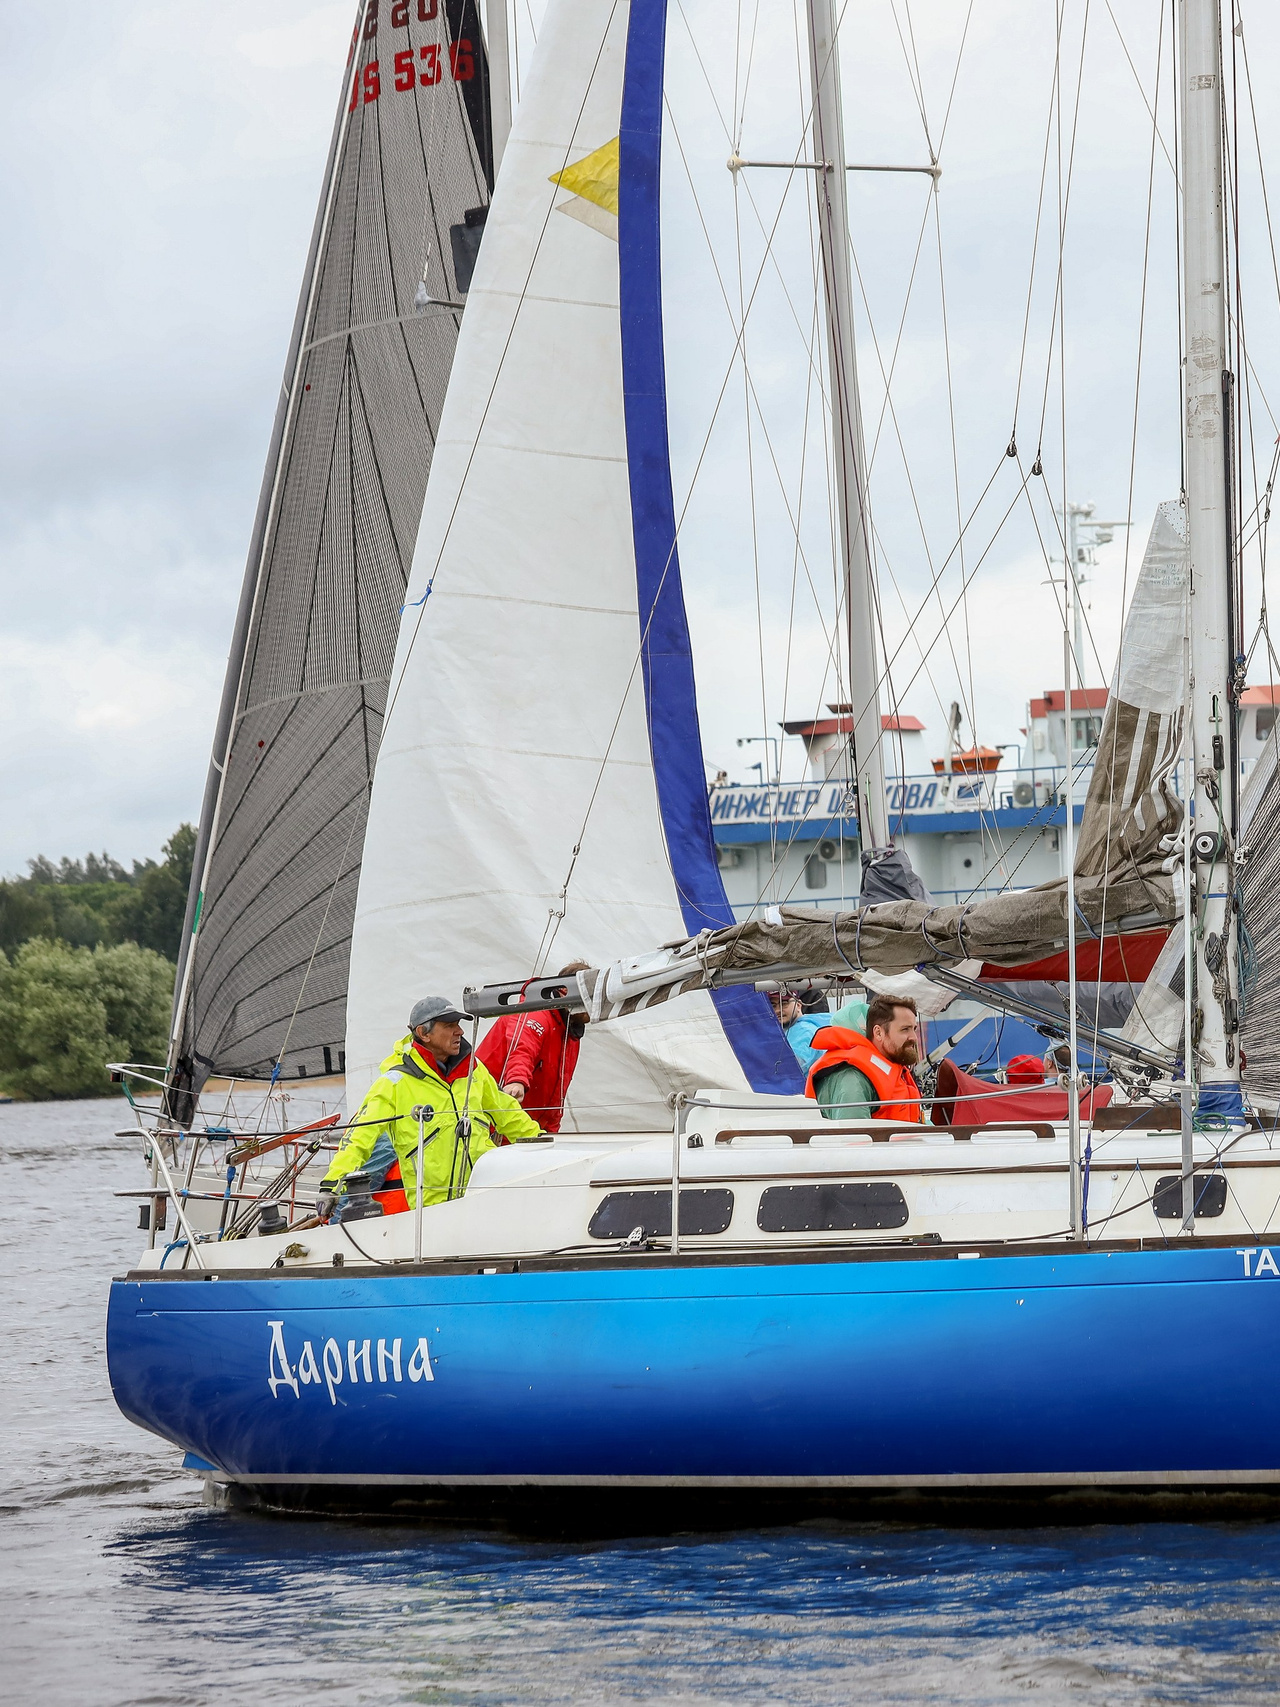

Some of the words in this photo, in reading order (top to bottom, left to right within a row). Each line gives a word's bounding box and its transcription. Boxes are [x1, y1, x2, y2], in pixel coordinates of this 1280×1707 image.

[394, 38, 475, 93] 536
[712, 789, 820, 819] ИНЖЕНЕР
[1236, 1248, 1280, 1276] TA
[267, 1320, 434, 1406] Дарина
